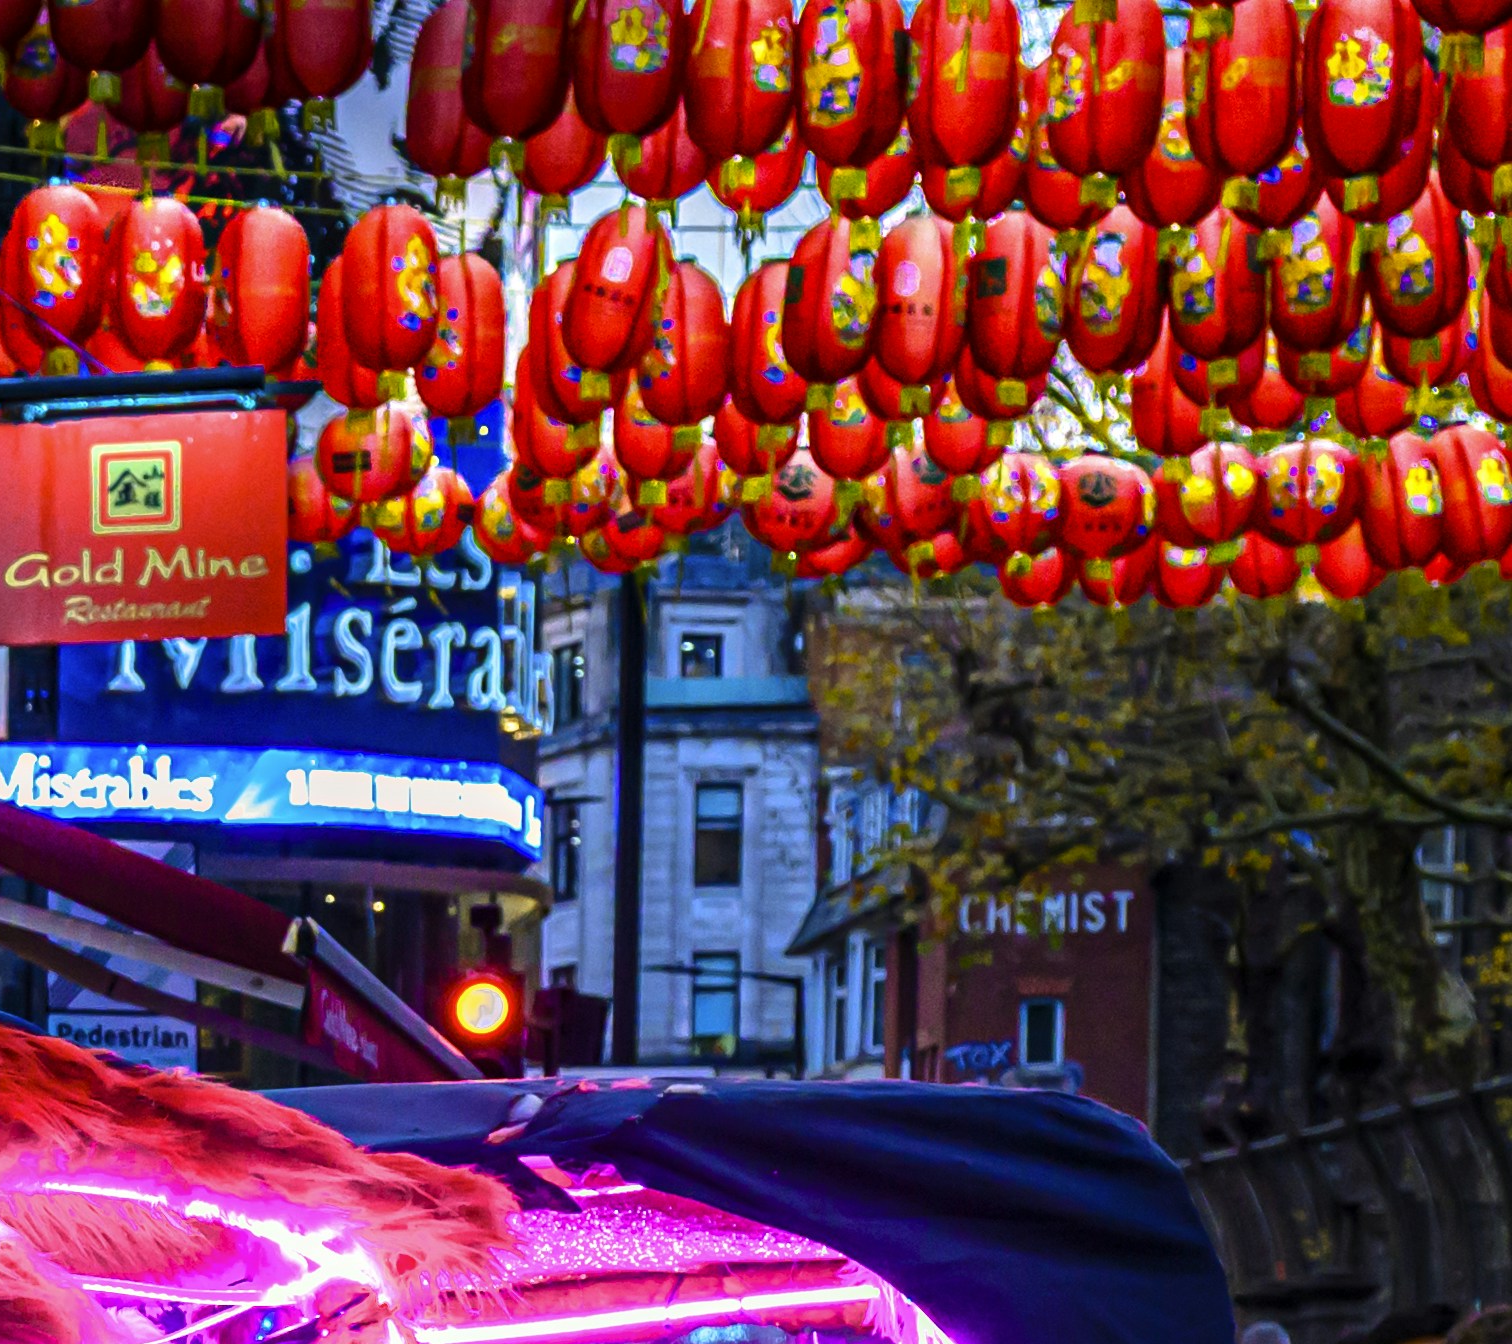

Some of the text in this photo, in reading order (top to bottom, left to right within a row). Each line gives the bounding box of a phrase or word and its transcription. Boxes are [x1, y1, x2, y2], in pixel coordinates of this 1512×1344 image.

[4, 544, 268, 589] Gold Mine
[64, 595, 212, 625] Restaurant
[56, 1022, 189, 1049] Pedestrian
